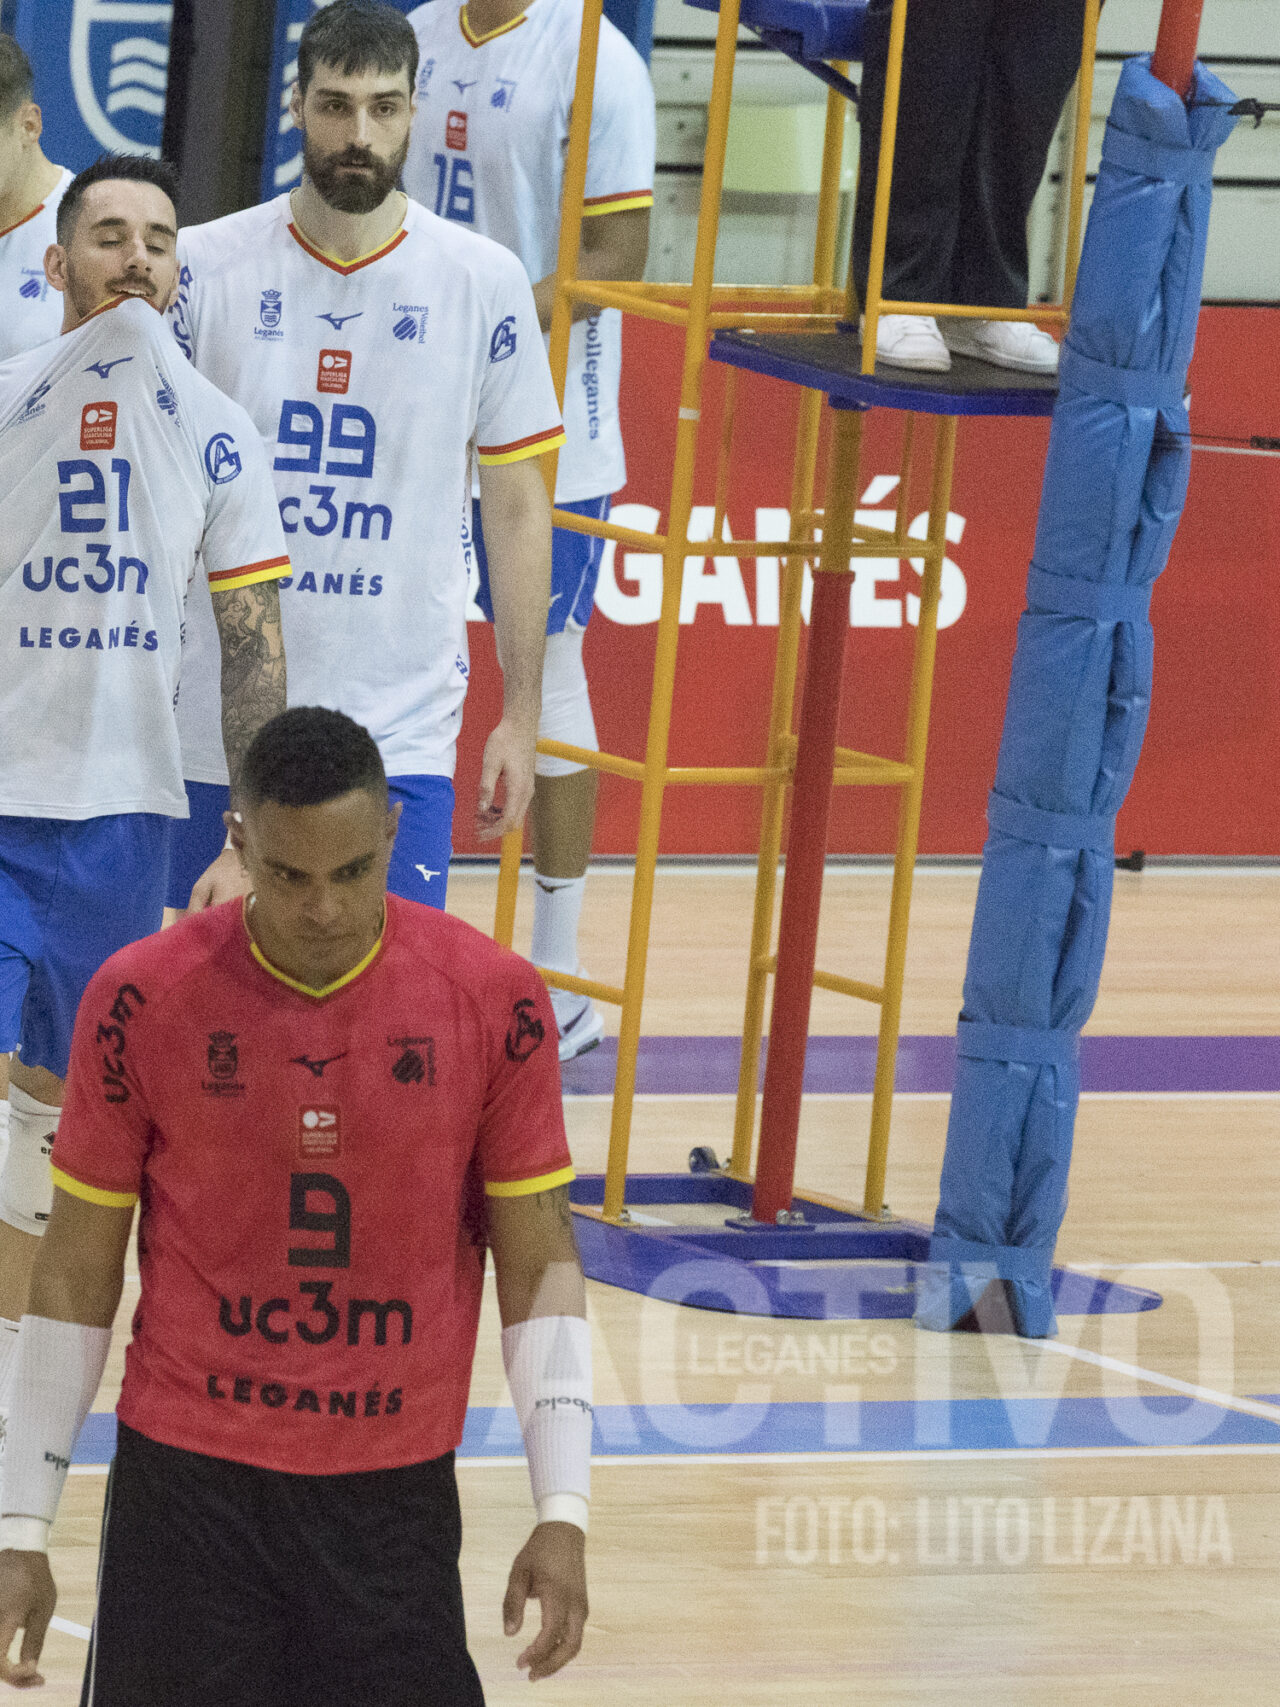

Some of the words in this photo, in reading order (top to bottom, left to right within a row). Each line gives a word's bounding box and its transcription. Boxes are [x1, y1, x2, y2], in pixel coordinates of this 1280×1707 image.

[433, 152, 475, 224] 16
[391, 302, 429, 314] Leganes
[272, 399, 377, 479] 99
[56, 457, 132, 533] 21
[278, 484, 393, 541] c3m
[278, 567, 384, 597] GANÉS
[19, 621, 159, 652] LEGANÉS
[96, 983, 147, 1104] uc3m
[287, 1171, 352, 1269] 9
[219, 1279, 414, 1347] uc3m
[206, 1374, 404, 1419] LEGANÉS
